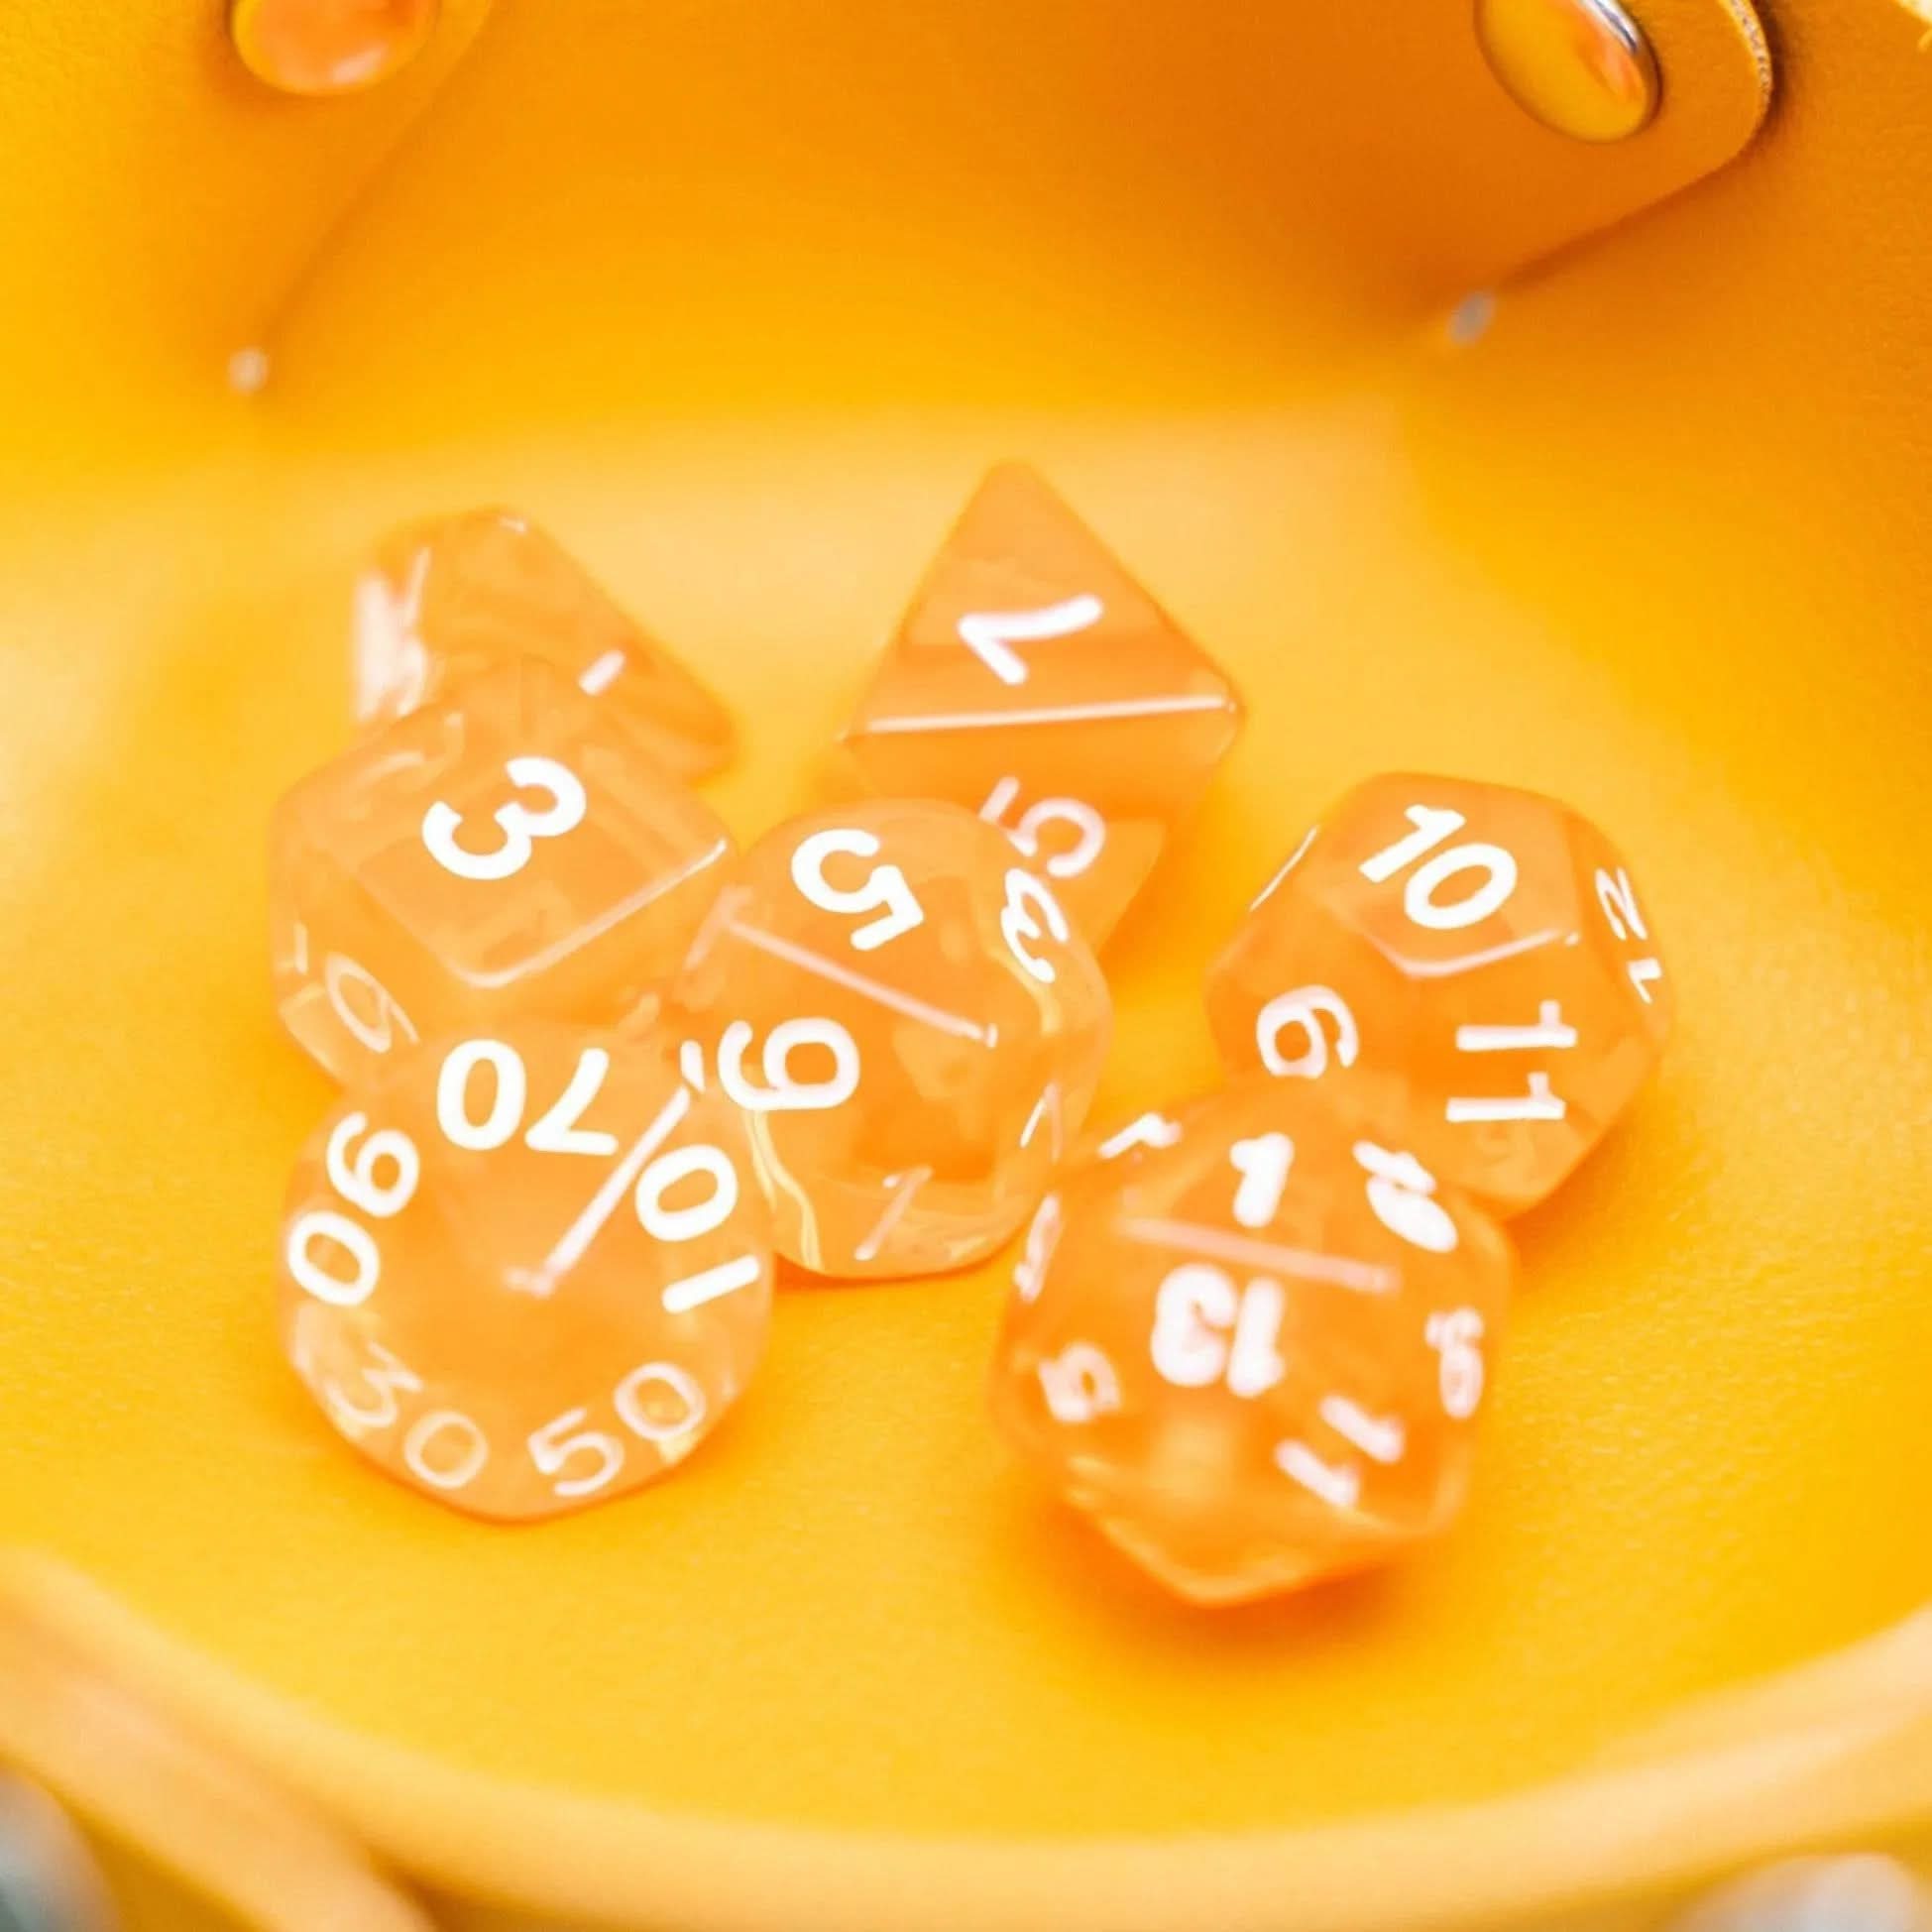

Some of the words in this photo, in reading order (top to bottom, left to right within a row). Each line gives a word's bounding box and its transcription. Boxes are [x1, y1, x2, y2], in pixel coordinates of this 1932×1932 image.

[421, 755, 586, 880] 3
[1359, 805, 1517, 929] 10
[791, 829, 924, 951] 5
[1000, 868, 1069, 983] 3
[436, 1038, 618, 1156] 70
[1446, 1000, 1577, 1122] 11
[635, 1144, 760, 1313] 10
[1151, 1264, 1284, 1398] 13
[325, 1342, 488, 1488] 30
[527, 1361, 706, 1498] 50
